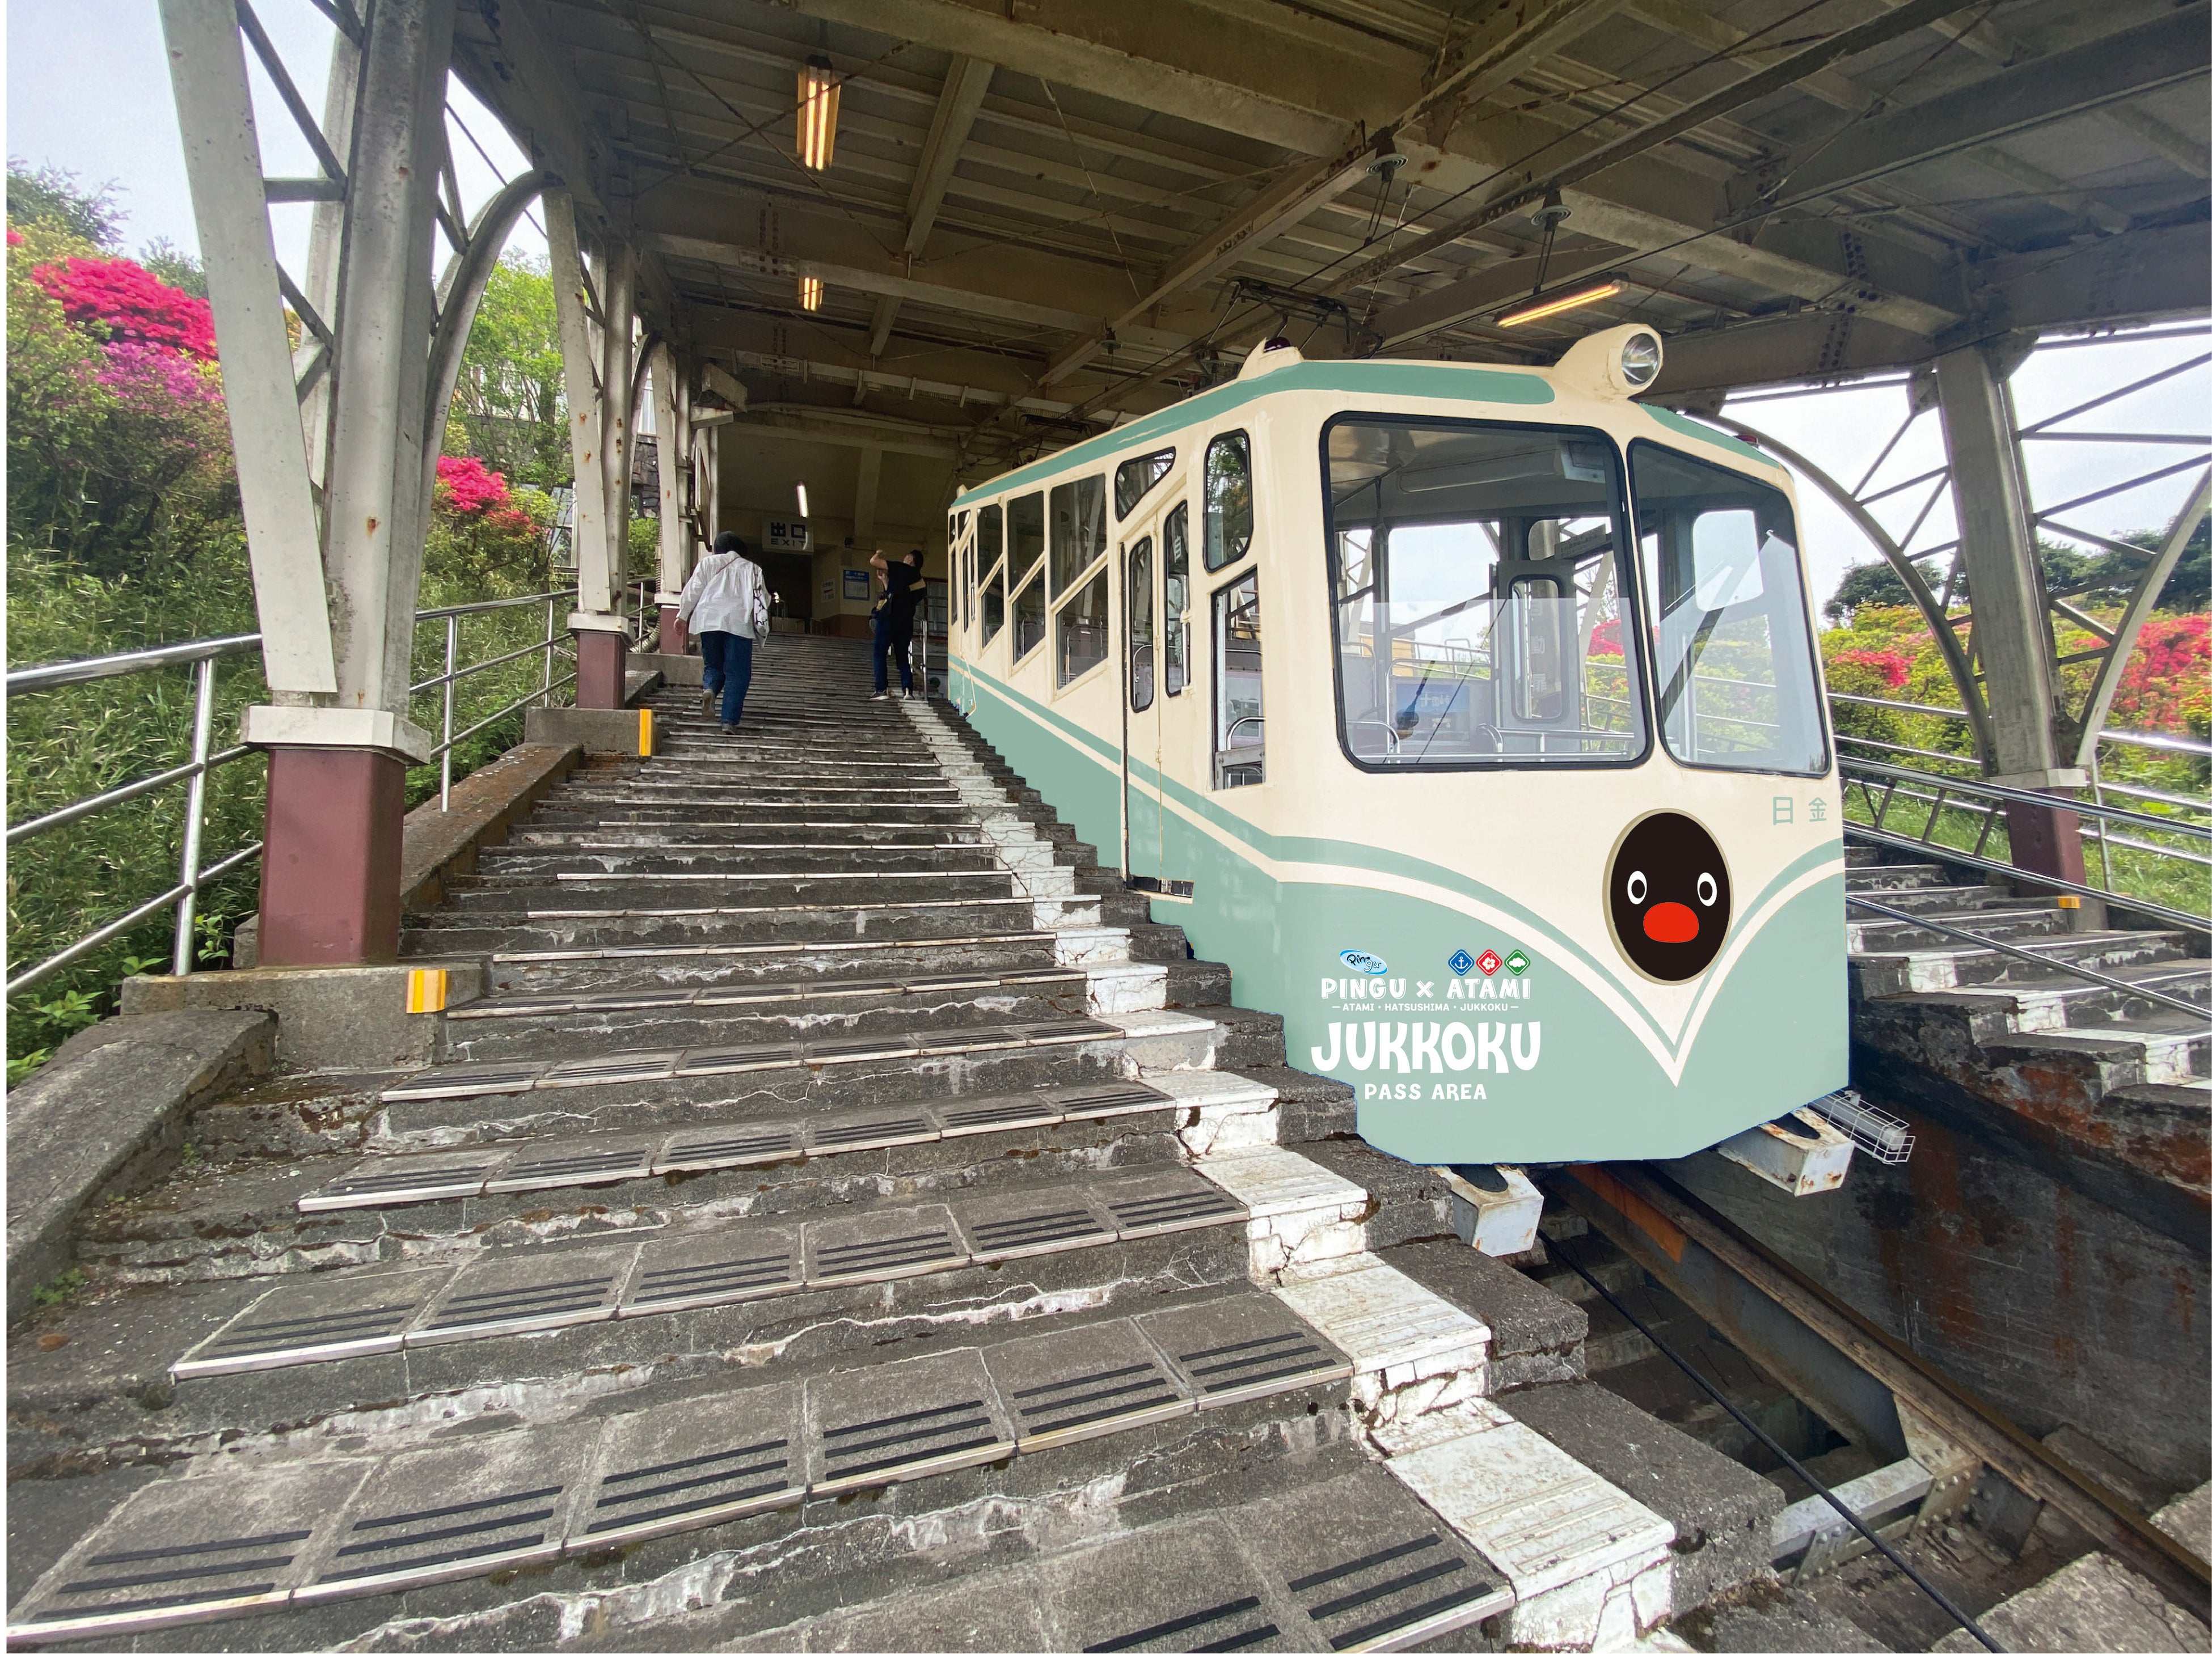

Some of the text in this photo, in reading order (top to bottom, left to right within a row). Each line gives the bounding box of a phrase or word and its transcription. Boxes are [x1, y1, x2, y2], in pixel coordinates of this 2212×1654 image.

[771, 522, 806, 539] 出口
[771, 538, 807, 547] EXIT
[1773, 796, 1827, 825] 日金
[1346, 954, 1380, 972] Pingu
[1321, 978, 1407, 1000] PINGU
[1446, 978, 1531, 1000] ATAMI
[1343, 1003, 1508, 1012] ATAMI HATSUSHIMA JUKKOKU
[1311, 1021, 1541, 1074] JUKKOKU
[1365, 1083, 1487, 1101] PASS AREA
